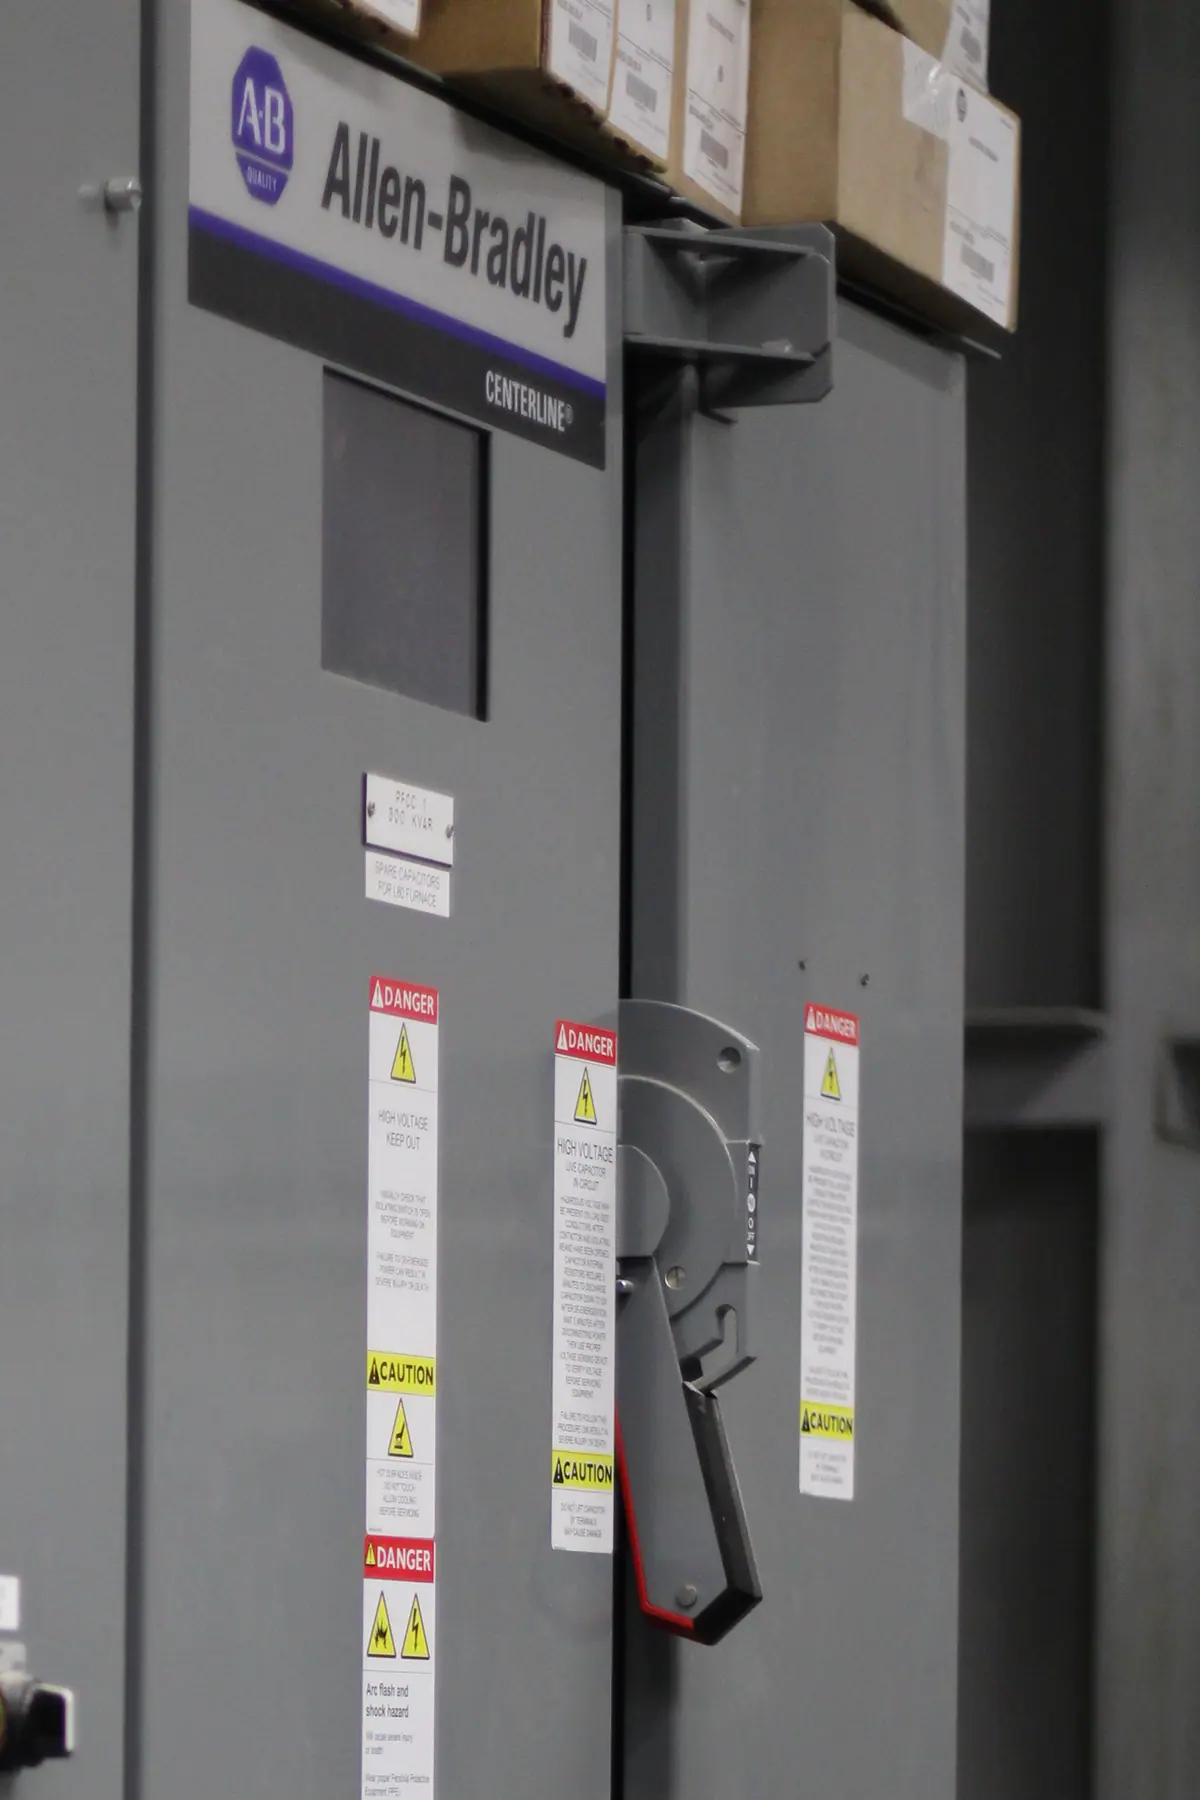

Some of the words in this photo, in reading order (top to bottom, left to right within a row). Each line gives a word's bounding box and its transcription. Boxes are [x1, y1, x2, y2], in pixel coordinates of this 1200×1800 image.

[246, 166, 277, 193] QUALITY
[321, 120, 587, 338] Allen-Bradley
[412, 814, 433, 832] KVAR
[399, 867, 440, 890] CAPACITORS
[406, 887, 436, 908] FURNACE
[384, 986, 435, 1016] DANGER
[816, 1010, 856, 1037] DANGER
[569, 1028, 613, 1058] DANGER
[378, 1109, 395, 1124] HIGH
[397, 1113, 428, 1131] VOLTAGE
[386, 1132, 404, 1145] KEEP
[405, 1135, 420, 1150] OUT
[557, 1137, 577, 1157] HIGH
[578, 1141, 613, 1164] VOLTAGE
[380, 1361, 434, 1386] CAUTION
[810, 1412, 853, 1434] CAUTION
[563, 1460, 612, 1484] CAUTION
[377, 1546, 431, 1573] DANGER
[366, 1683, 377, 1696] Arc
[379, 1682, 395, 1697] flash
[396, 1684, 409, 1697] and
[365, 1704, 386, 1717] shock
[387, 1704, 409, 1718] hazard
